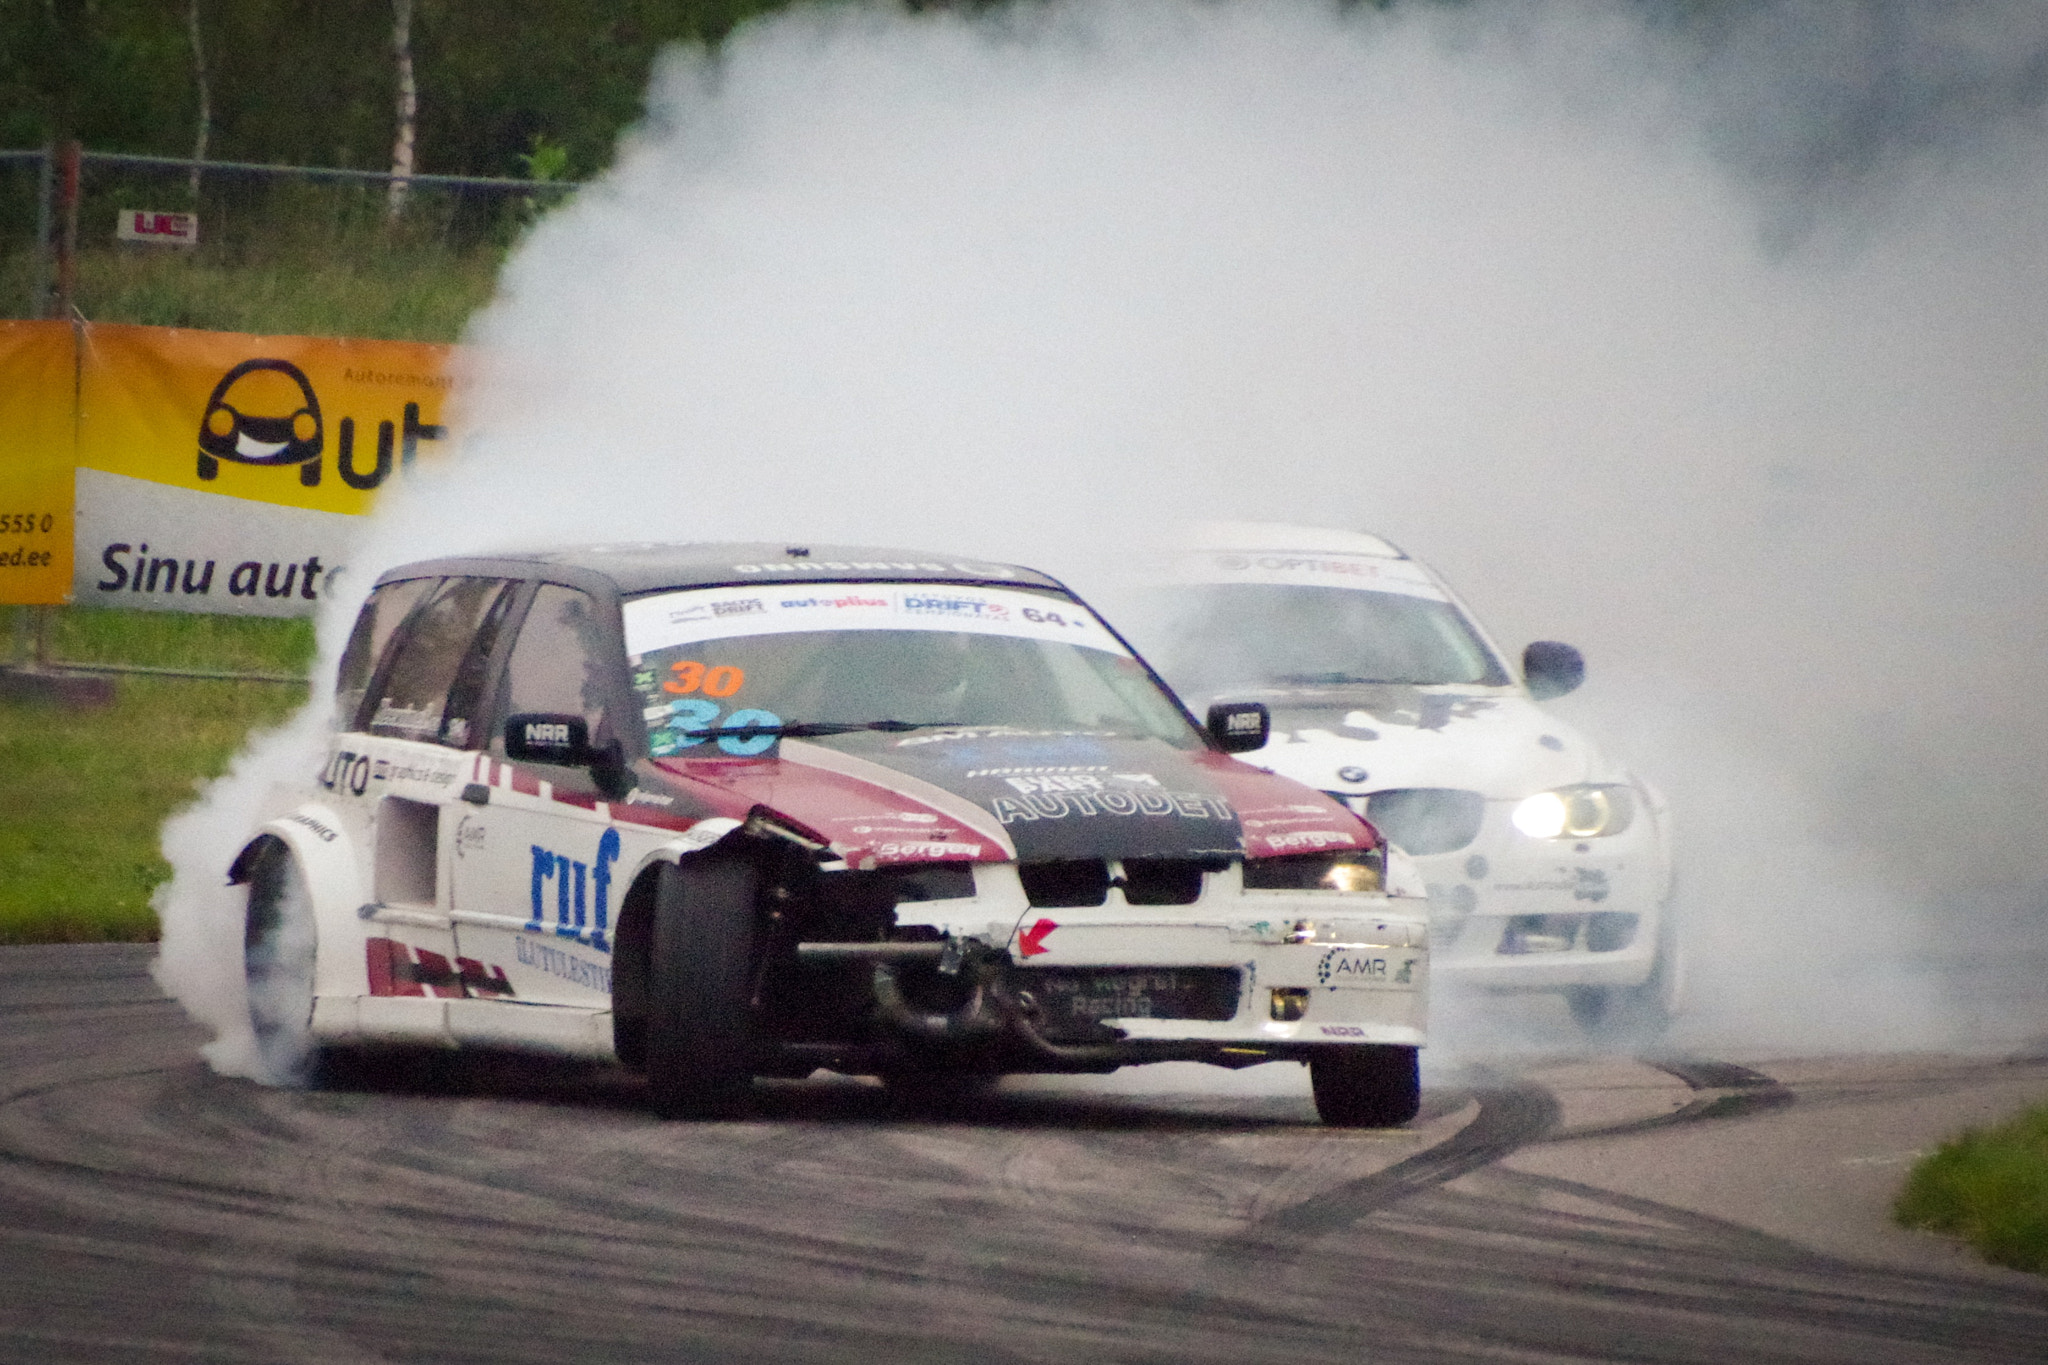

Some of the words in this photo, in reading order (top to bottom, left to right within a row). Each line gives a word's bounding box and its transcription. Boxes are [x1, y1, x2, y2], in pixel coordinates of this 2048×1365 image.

[97, 542, 215, 593] Sinu
[662, 660, 745, 698] 30
[1336, 957, 1387, 976] AMR
